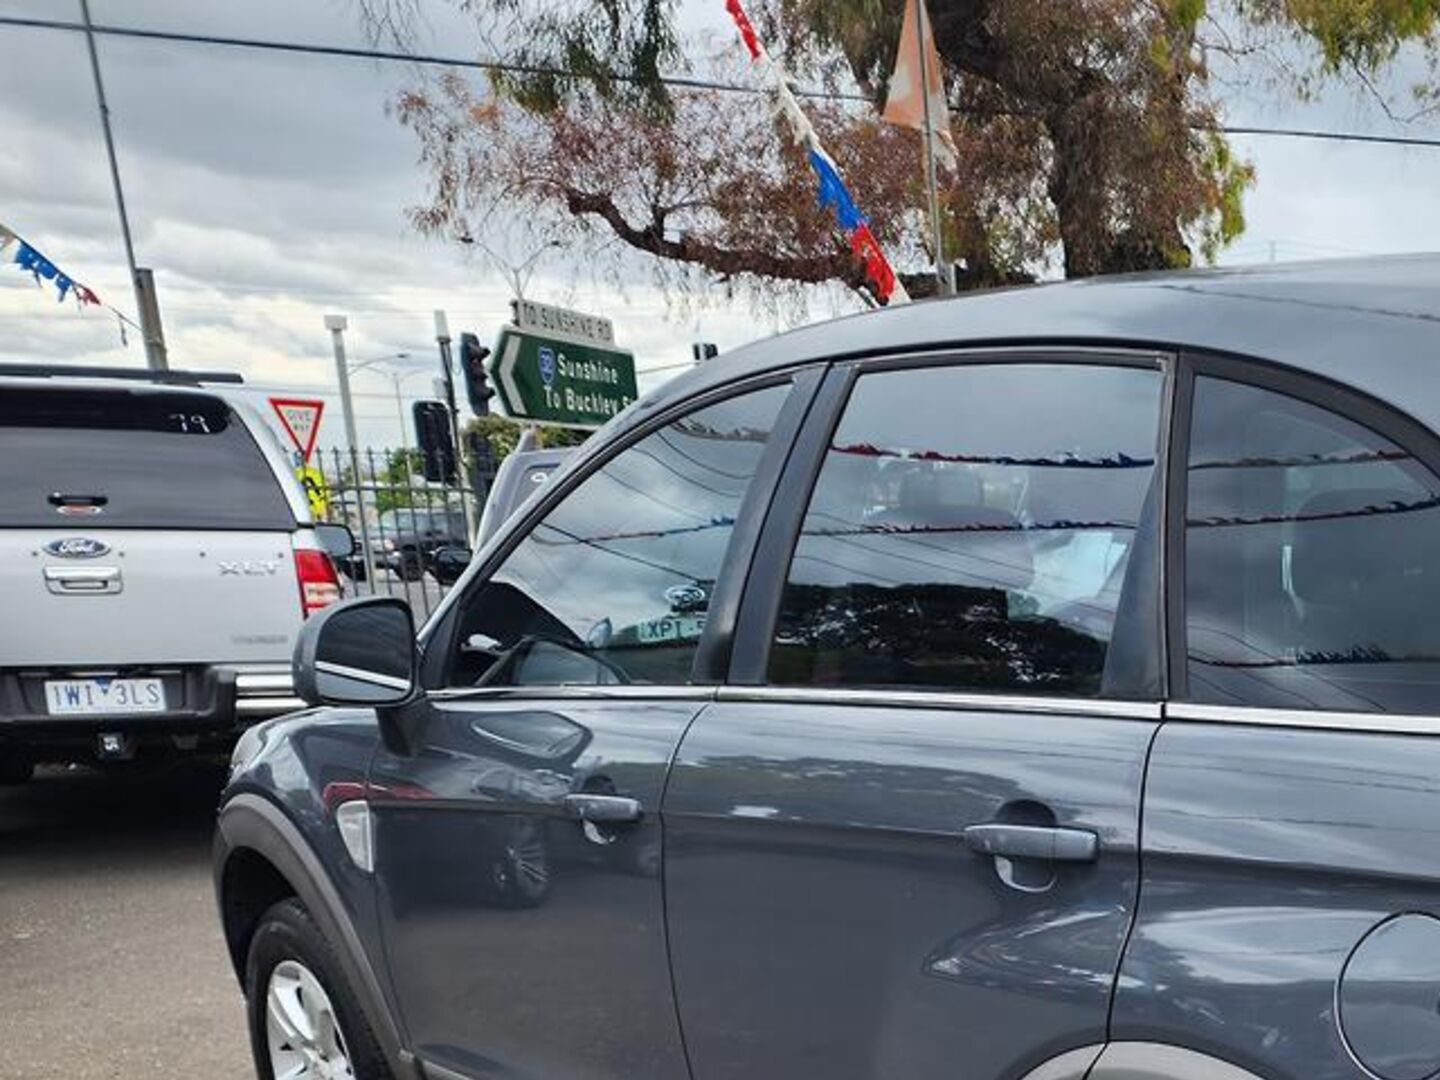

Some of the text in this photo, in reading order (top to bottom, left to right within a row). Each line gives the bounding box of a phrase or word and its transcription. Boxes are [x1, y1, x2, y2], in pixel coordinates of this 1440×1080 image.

[557, 352, 618, 384] Sunshine
[543, 385, 561, 409] To
[564, 387, 618, 416] Buckley
